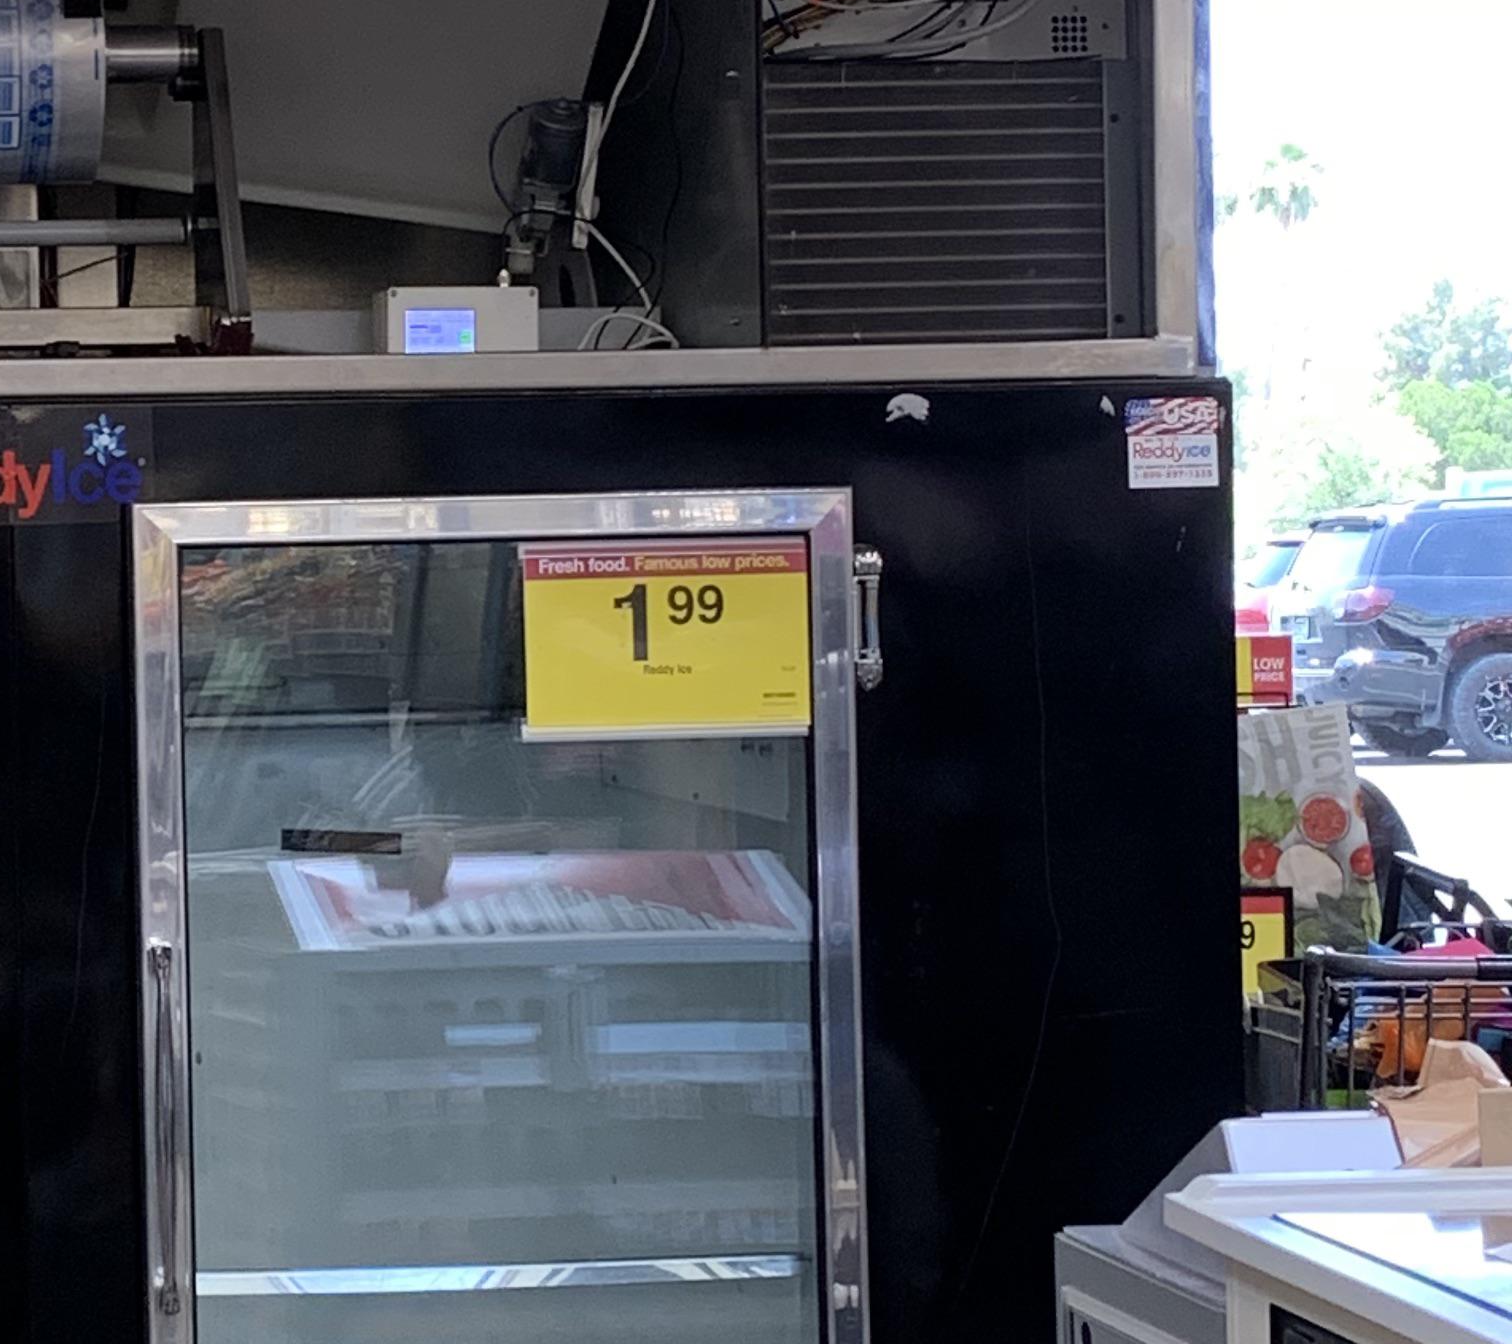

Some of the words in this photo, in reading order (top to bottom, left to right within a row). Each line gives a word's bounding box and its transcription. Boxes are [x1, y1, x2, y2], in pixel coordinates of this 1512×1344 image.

[539, 557, 585, 575] Fresh
[587, 556, 631, 573] food.
[634, 555, 699, 571] Famous
[701, 554, 732, 569] low
[734, 552, 790, 571] prices.
[613, 583, 649, 662] 1
[667, 584, 724, 625] 99
[1253, 657, 1286, 670] LOW
[1254, 671, 1286, 683] PRICE
